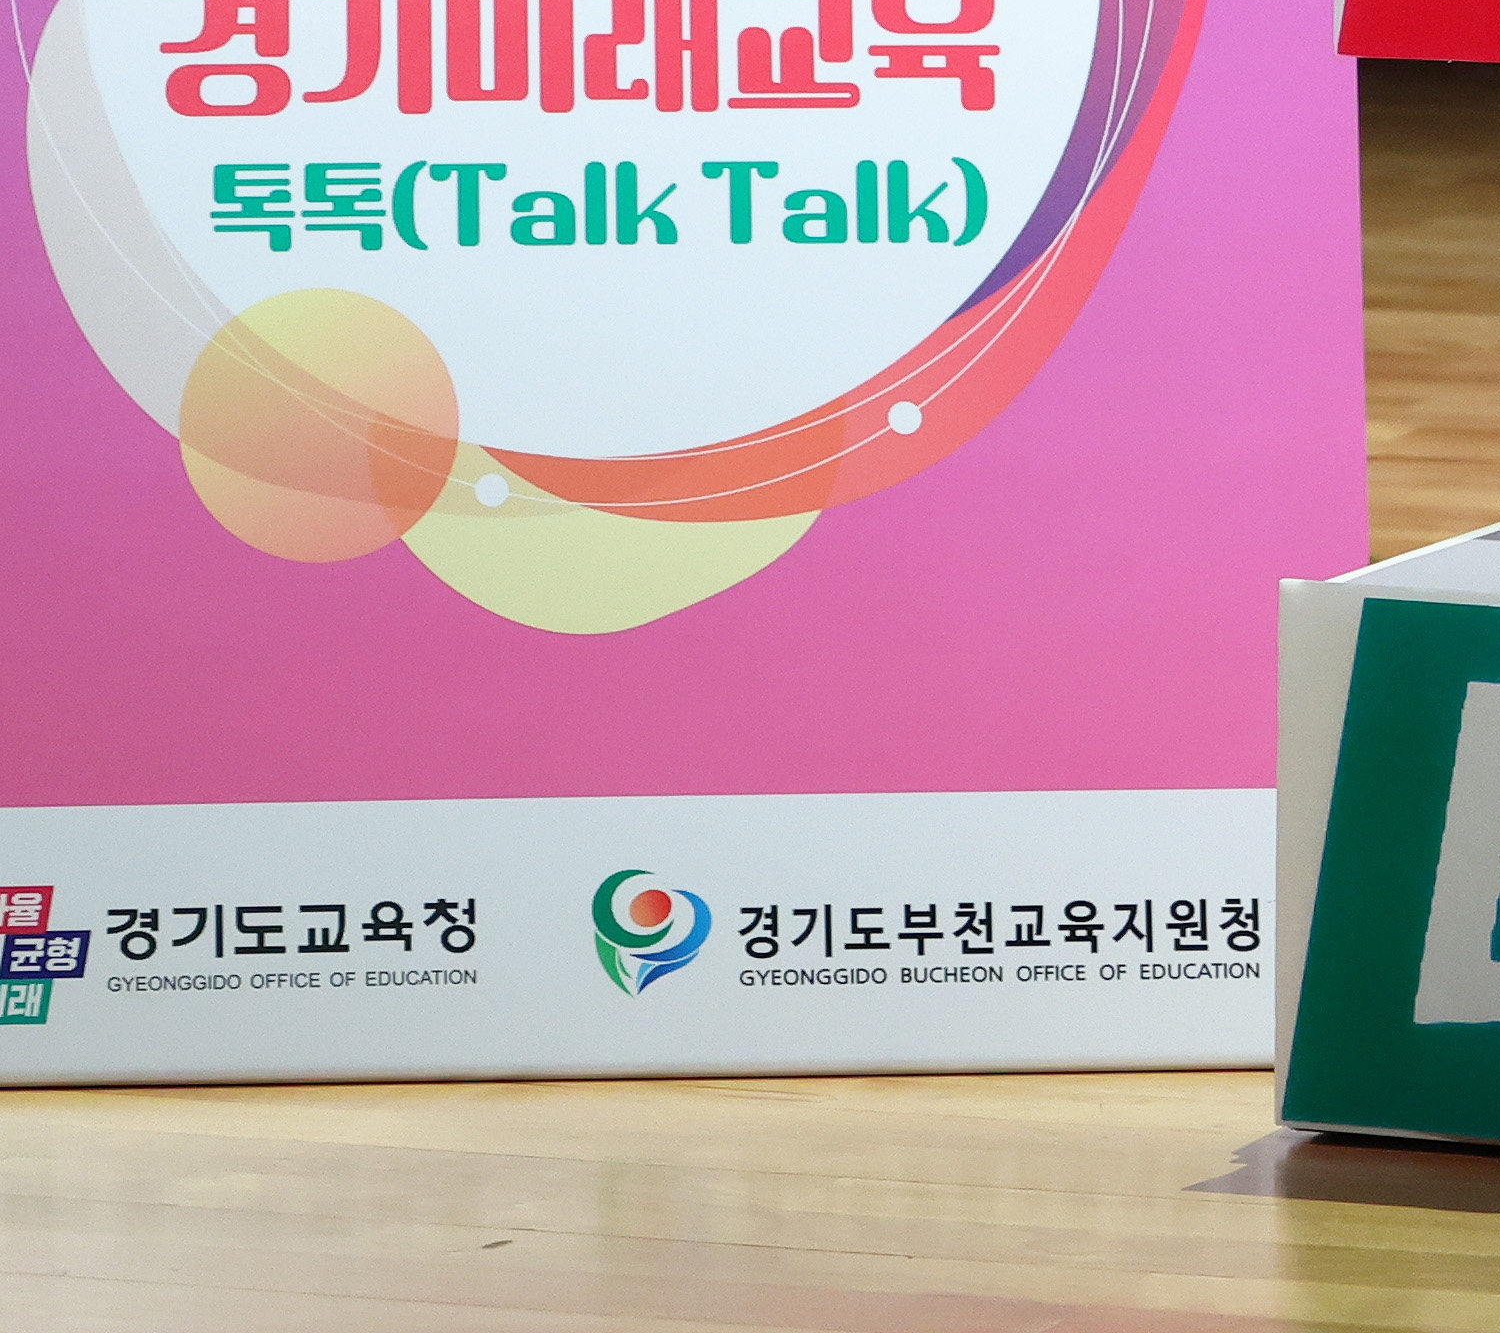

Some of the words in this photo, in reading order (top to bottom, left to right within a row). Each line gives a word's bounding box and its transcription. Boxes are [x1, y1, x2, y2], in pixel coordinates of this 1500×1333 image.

[211, 161, 677, 252] 톡톡(Talk
[702, 157, 987, 246] Talk)
[0, 892, 43, 927] 율
[107, 898, 475, 960] 경기도교육청
[738, 899, 1260, 959] 경기도부천교육지원청
[9, 937, 82, 973] 균형
[108, 975, 241, 992] GYEONGGIDO
[251, 973, 320, 989] OFFICE
[330, 972, 355, 987] OF
[366, 970, 476, 986] EDUCATION
[740, 968, 887, 986] GYEONGGIDO
[902, 966, 1002, 983] BUCHEON
[1017, 965, 1085, 981] OFFICE
[1100, 964, 1126, 980] OF
[1140, 963, 1259, 979] EDUCATION
[0, 983, 44, 1017] 래
